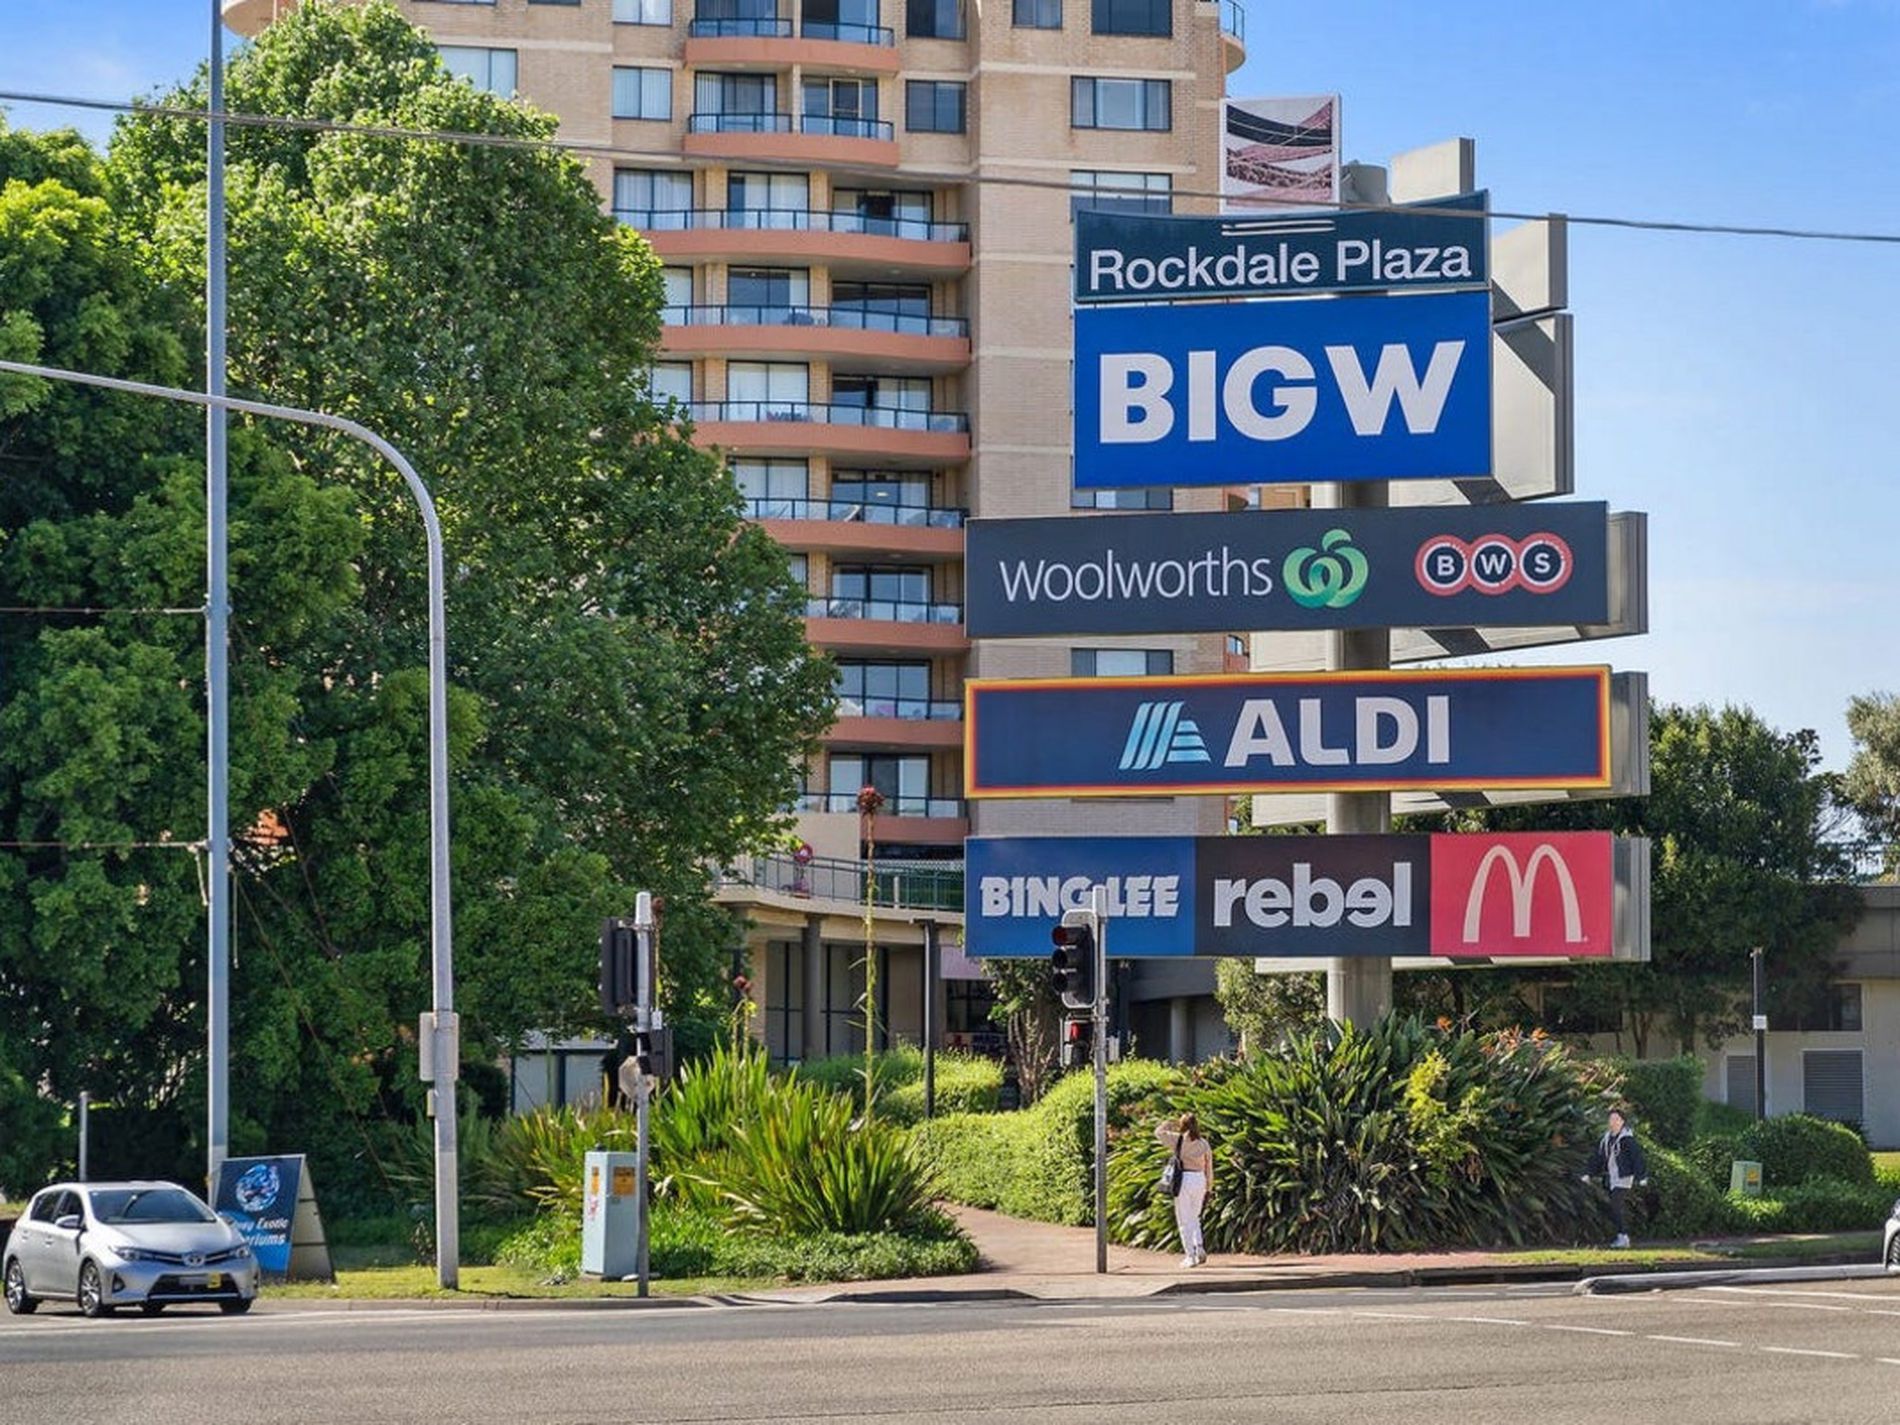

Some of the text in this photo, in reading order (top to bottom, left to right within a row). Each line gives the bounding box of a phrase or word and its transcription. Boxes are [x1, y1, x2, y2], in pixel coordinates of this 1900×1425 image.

[1090, 239, 1473, 291] Rockdale Plaza
[999, 546, 1273, 602] Woolworths
[1223, 695, 1450, 768] ALDI
[1213, 861, 1412, 928] rebel
